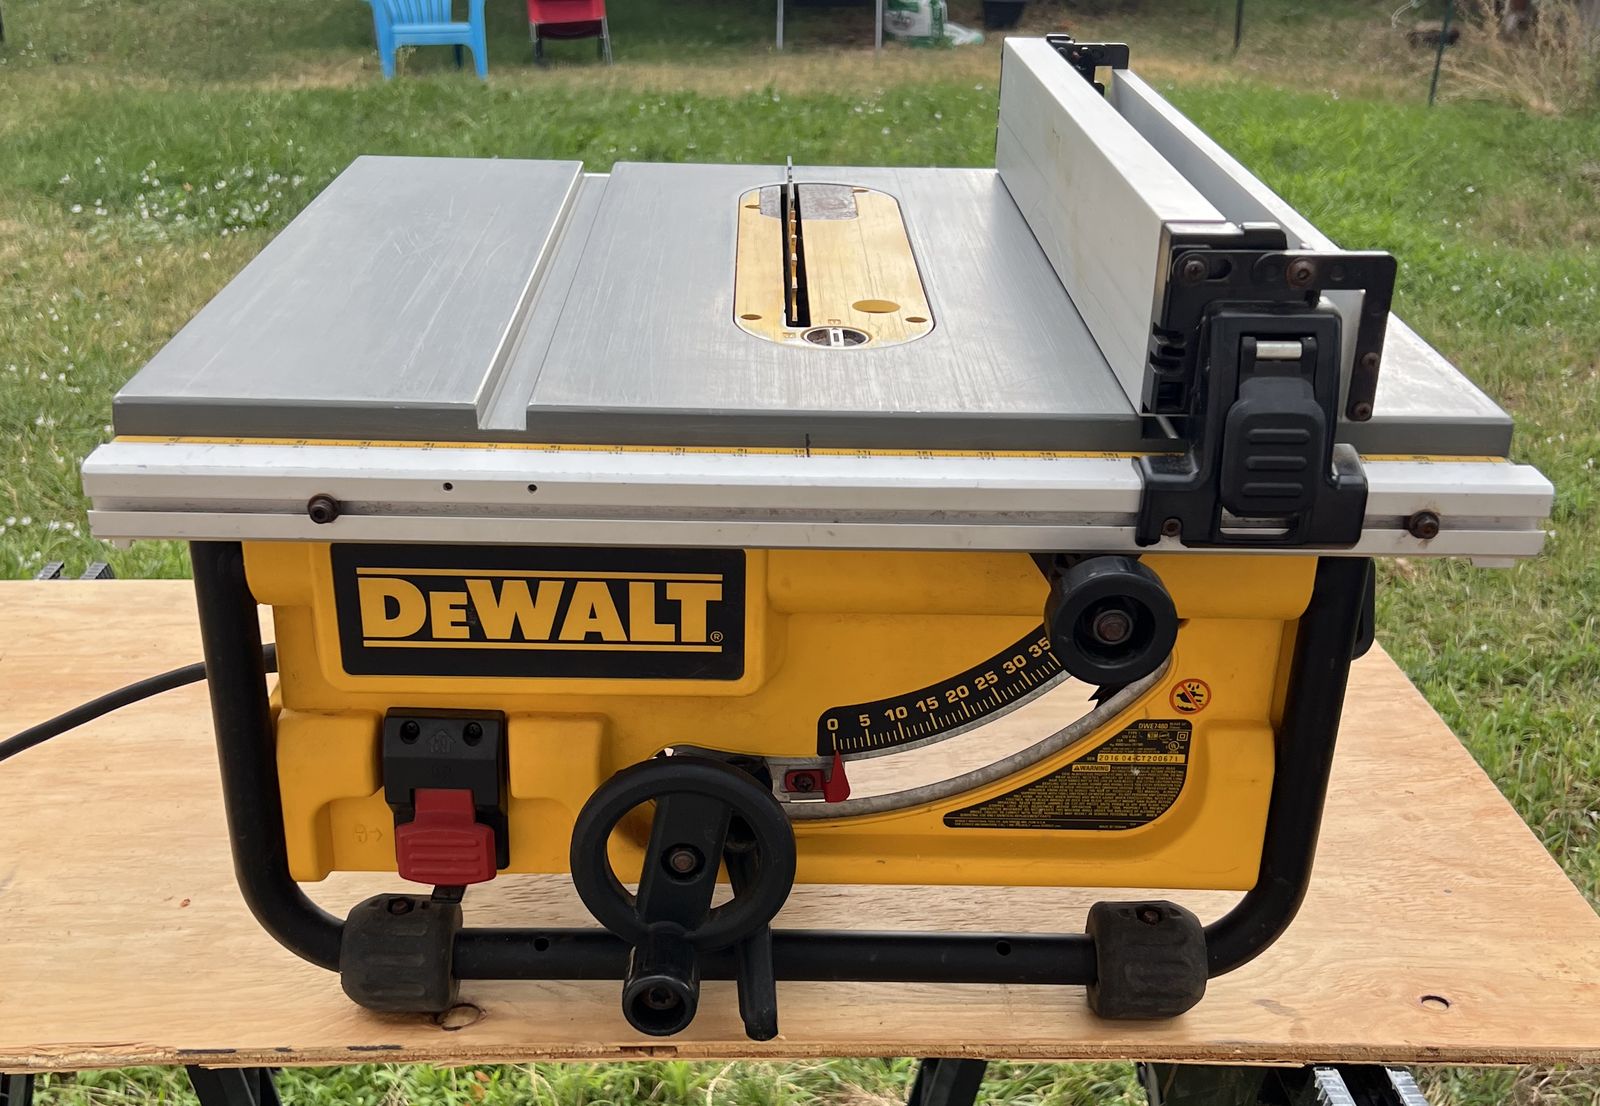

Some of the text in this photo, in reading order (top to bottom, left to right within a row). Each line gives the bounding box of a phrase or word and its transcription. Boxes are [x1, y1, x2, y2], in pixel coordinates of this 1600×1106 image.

[827, 637, 1050, 730] 0 5 10 15 20 25 30 35
